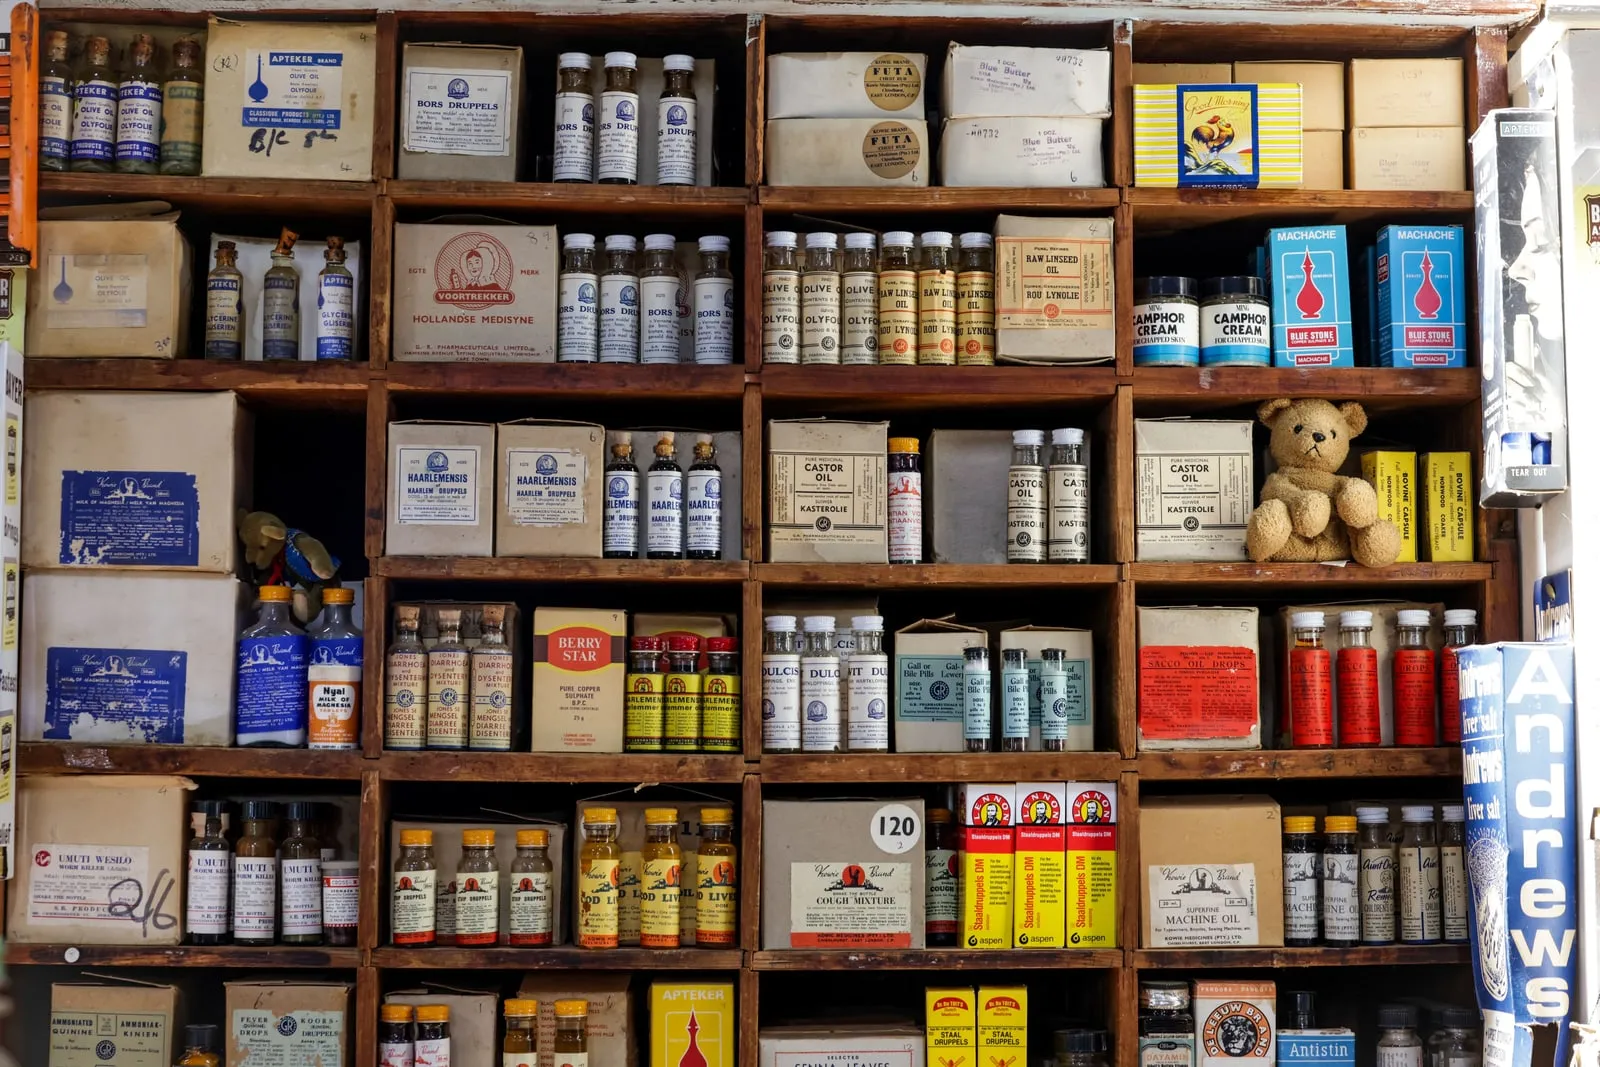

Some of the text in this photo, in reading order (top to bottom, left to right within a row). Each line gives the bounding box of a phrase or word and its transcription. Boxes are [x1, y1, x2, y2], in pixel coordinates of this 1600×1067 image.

[271, 55, 313, 64] APTEKER
[873, 67, 913, 76] FUTA
[979, 62, 1031, 78] Blue Butter
[417, 100, 498, 111] BORS DRUPPELS
[1214, 95, 1251, 112] Morning
[120, 107, 154, 116] OLIVE OIL
[120, 121, 152, 131] OLYFOLIE
[872, 134, 912, 146] FUTA
[1022, 136, 1073, 146] Blue Butter
[1277, 230, 1336, 241] MACHACHE
[1397, 230, 1455, 241] MACHACHE
[1026, 254, 1079, 264] RAW LINSEED
[520, 268, 540, 276] MERK
[1046, 266, 1059, 275] OIL
[803, 284, 832, 293] OLIVE
[845, 286, 874, 295] OLIVE
[438, 292, 510, 301] VOORTREKKER
[1026, 290, 1080, 300] ROU LYNOLIE
[648, 309, 671, 317] BORS
[698, 310, 721, 318] BORS
[413, 315, 534, 324] HOLLANDSE MEDISYNE
[1214, 314, 1267, 325] CAMPHOR
[1222, 325, 1262, 336] CREAM
[1290, 331, 1334, 340] BLUE STONE
[1408, 331, 1451, 340] BLUE STONE
[1297, 356, 1329, 364] MACHACHE
[1415, 356, 1446, 364] MACHACHE
[804, 463, 843, 473] CASTOR
[1170, 464, 1209, 474] CASTOR
[1511, 468, 1547, 476] TEAR OUT
[408, 472, 468, 484] HAARLEMENSIS
[517, 476, 577, 487] HAARLEMENSIS
[815, 473, 833, 482] OIL
[1182, 474, 1198, 483] OIL
[1010, 479, 1043, 488] CASTOR
[407, 487, 468, 495] HAARLEM DRUPPELS
[548, 490, 577, 498] DRUPPELS
[1017, 489, 1033, 498] OIL
[800, 505, 848, 513] KASTEROLIE
[1167, 505, 1215, 514] KASTEROLIE
[1401, 472, 1410, 541] BOVINE CAPSULE
[1456, 506, 1464, 541] CAPSULE
[1535, 603, 1571, 640] Andrews
[558, 637, 602, 650] BERRY
[563, 650, 597, 662] STAR
[907, 662, 921, 670] Gall
[1148, 660, 1246, 669] SACCO OIL DROPS
[903, 670, 934, 678] Bile Pills
[322, 686, 346, 697] Nyal
[477, 722, 507, 730] DIARREE
[1463, 748, 1503, 786] Andrews
[972, 792, 1011, 825] LENNON
[1021, 790, 1060, 822] LENNON
[1072, 790, 1111, 822] LENNON
[1467, 798, 1500, 822] liver salt
[879, 816, 915, 837] 120
[1506, 650, 1576, 1019] Andrews
[58, 854, 132, 865] UMUTI WESILO
[238, 863, 268, 872] UMUTI
[284, 866, 313, 874] UMUTI
[973, 858, 984, 931] Staaldruppels DM
[1024, 856, 1034, 929] Staaldruppels DM
[1076, 856, 1086, 929] Staaldruppels DM
[816, 896, 896, 905] COUGH MIXTURE
[1166, 914, 1240, 925] MACHINE OIL
[978, 937, 1003, 948] aspen
[1030, 935, 1054, 946] aspen
[1082, 933, 1106, 944] aspen
[663, 990, 725, 1000] APTEKER
[52, 1018, 93, 1027] AMMONIATED
[52, 1028, 93, 1036] QUININE
[1208, 1003, 1269, 1057] DE LEEUW BRAND
[934, 1038, 969, 1046] DRUPPELS
[1289, 1043, 1348, 1058] Antistin
